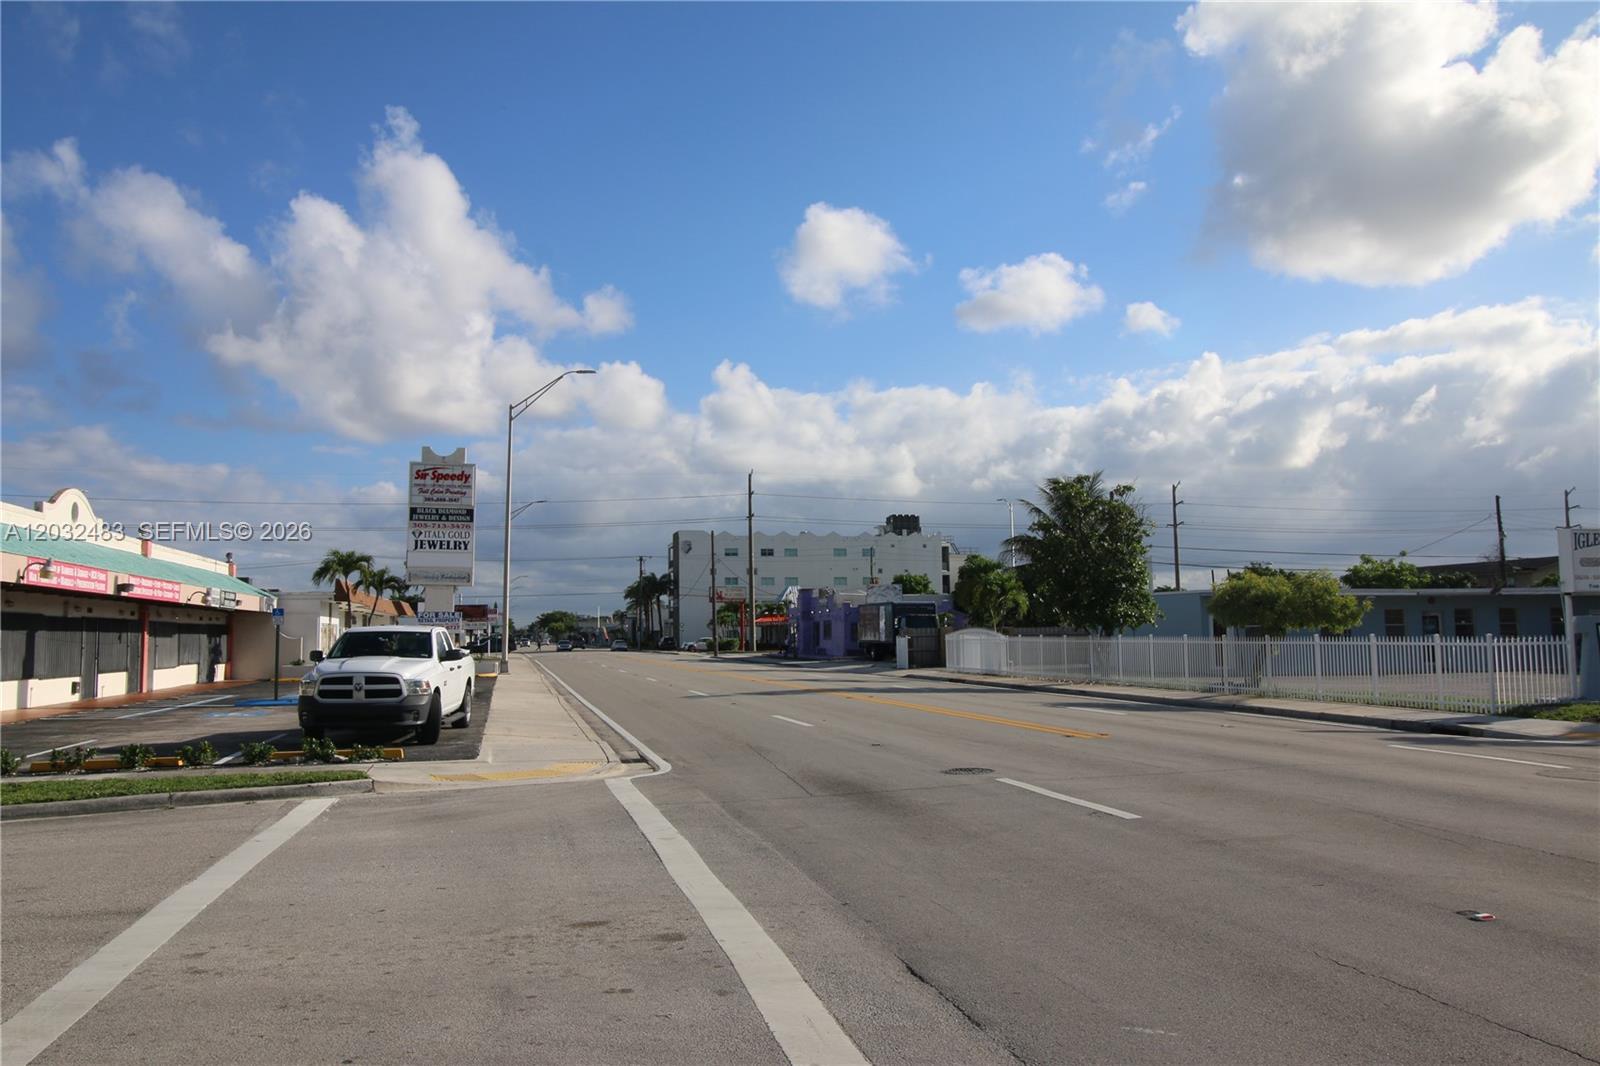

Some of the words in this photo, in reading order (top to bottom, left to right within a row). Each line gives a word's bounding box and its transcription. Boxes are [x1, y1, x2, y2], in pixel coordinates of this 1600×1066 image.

[414, 469, 429, 480] Sir
[431, 470, 471, 483] Speedy
[424, 531, 447, 539] ITALY
[447, 531, 471, 539] GOLD
[413, 540, 470, 551] JEWELRY
